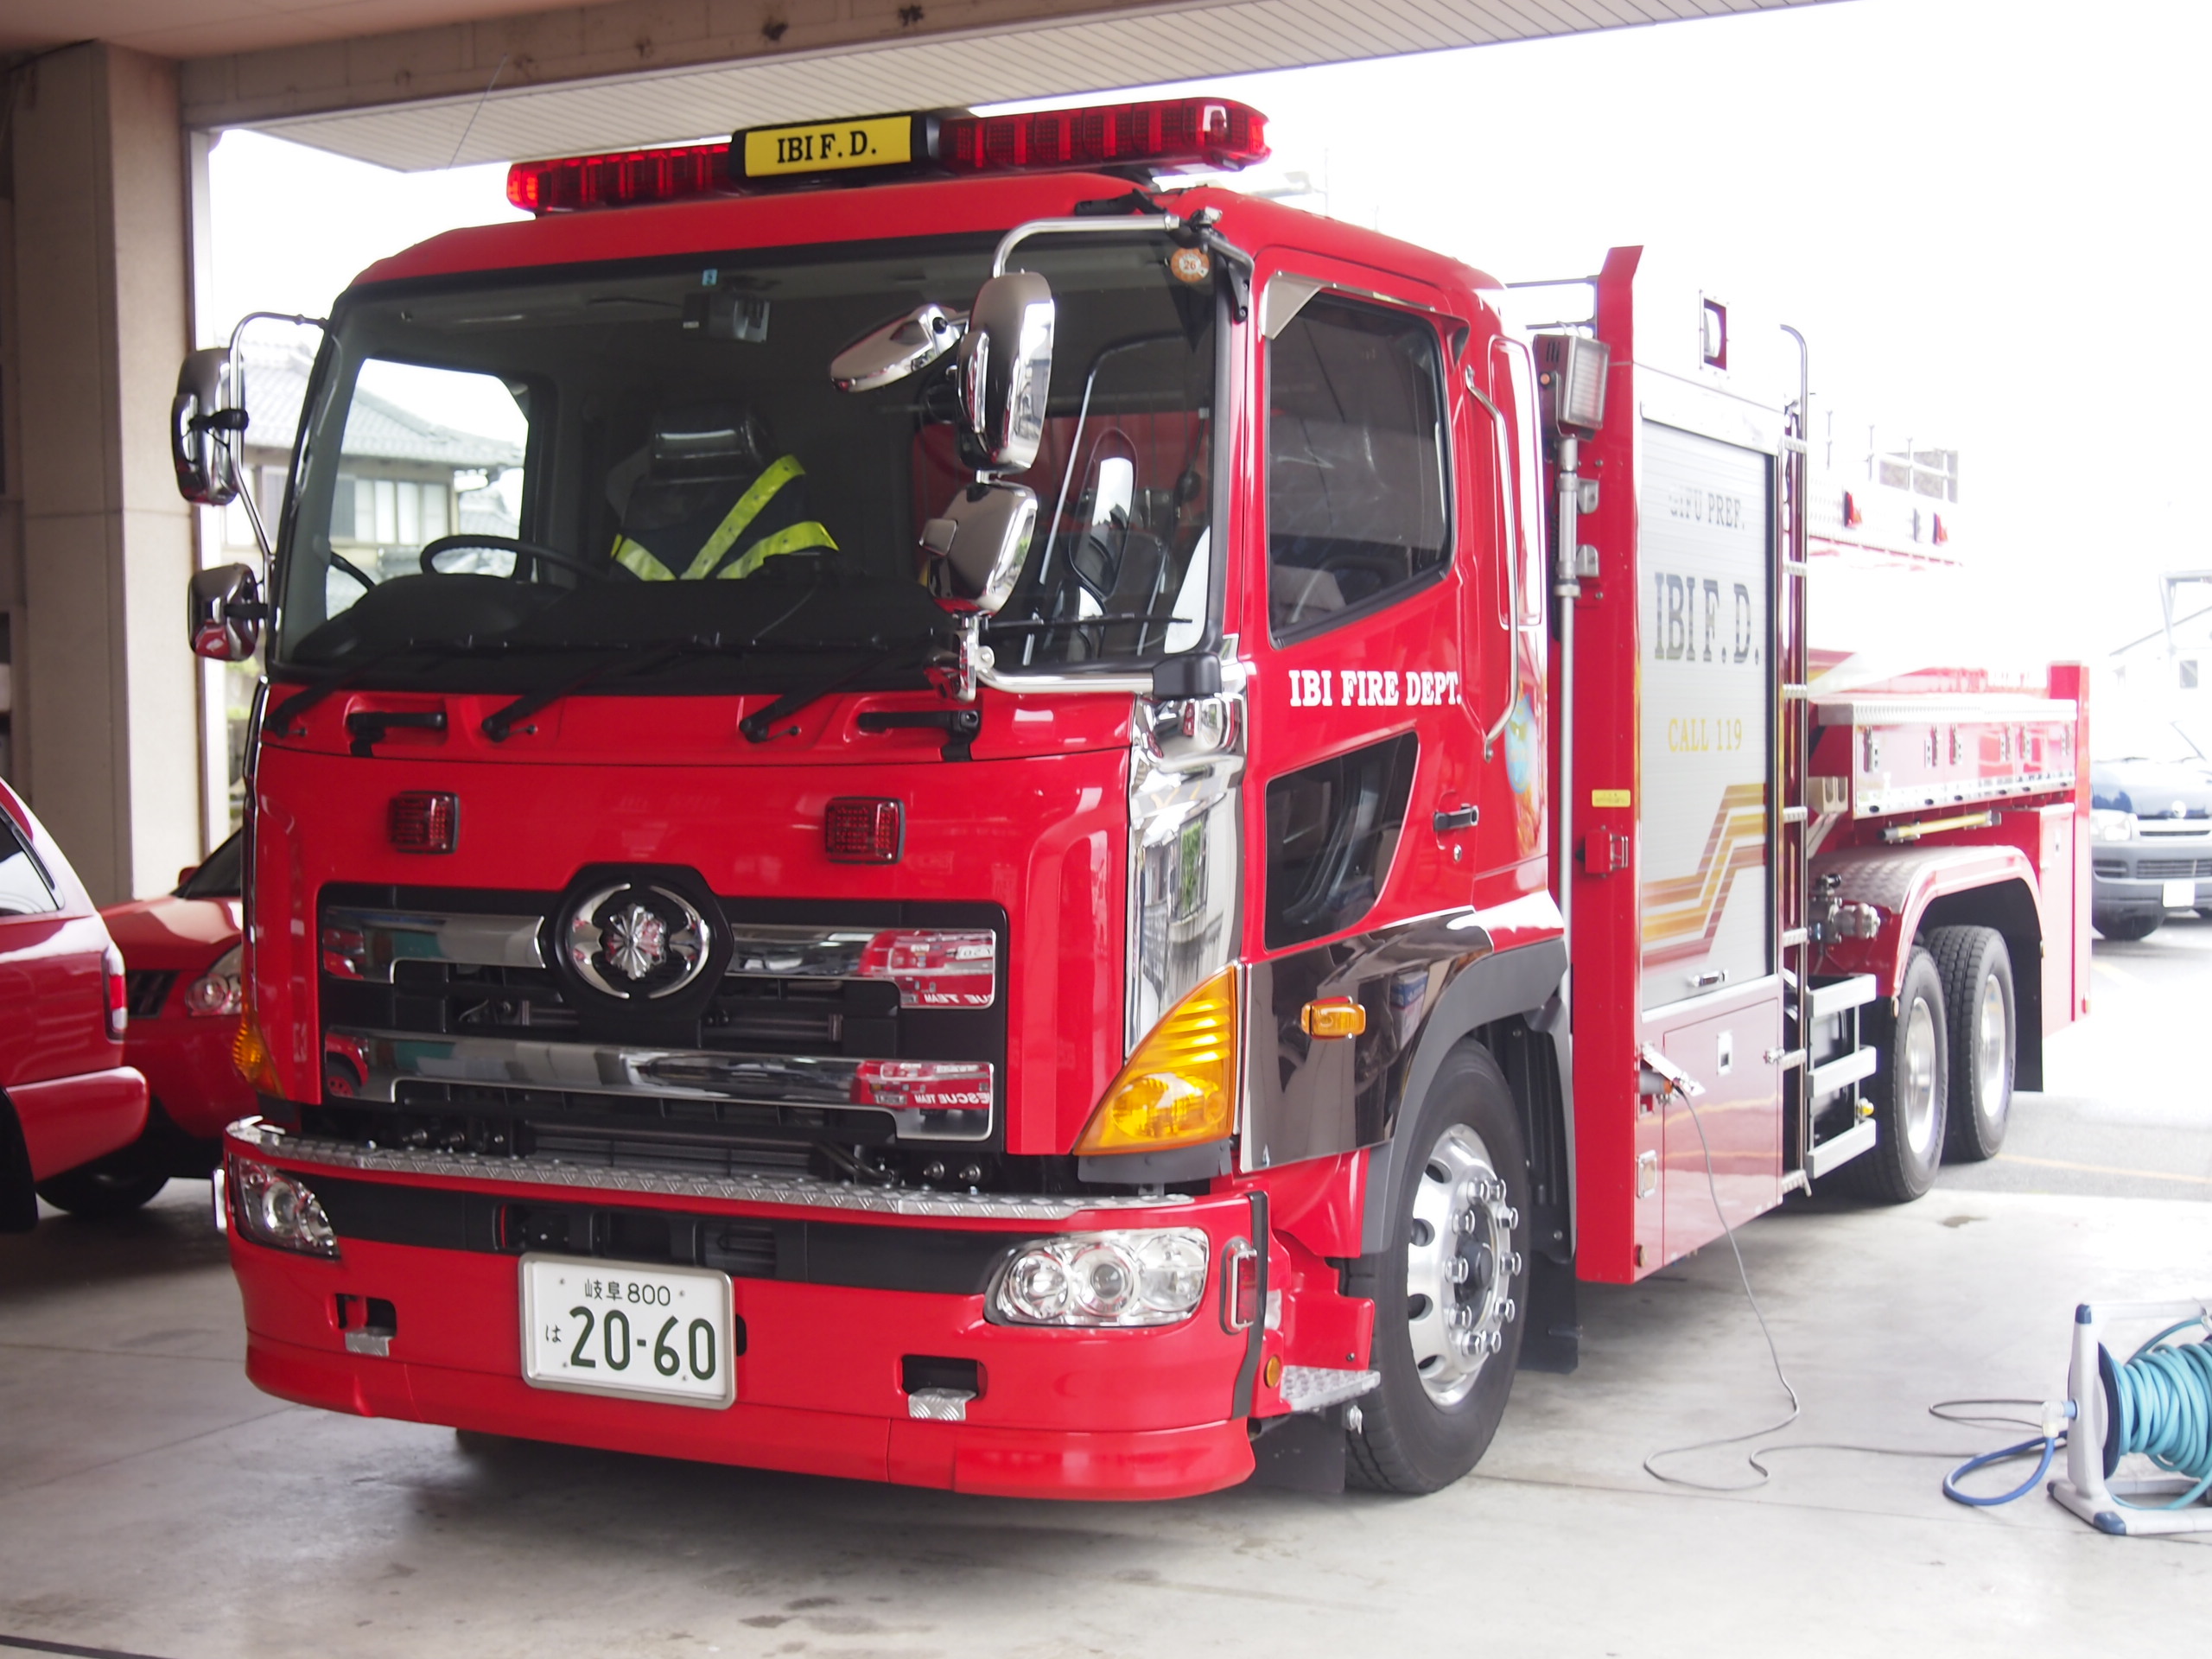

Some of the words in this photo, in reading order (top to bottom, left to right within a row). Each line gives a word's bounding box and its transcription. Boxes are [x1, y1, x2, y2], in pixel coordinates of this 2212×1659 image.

[777, 135, 813, 163] IBI
[1707, 492, 1745, 531] PREF.
[1654, 571, 1695, 662] IBI
[1287, 670, 1333, 707] IBI
[1340, 670, 1400, 707] FIRE
[1405, 671, 1462, 706] DEPT.
[1668, 717, 1710, 753] CALL
[1716, 717, 1743, 751] 119
[545, 1325, 562, 1344] は
[569, 1305, 716, 1381] 20-60
